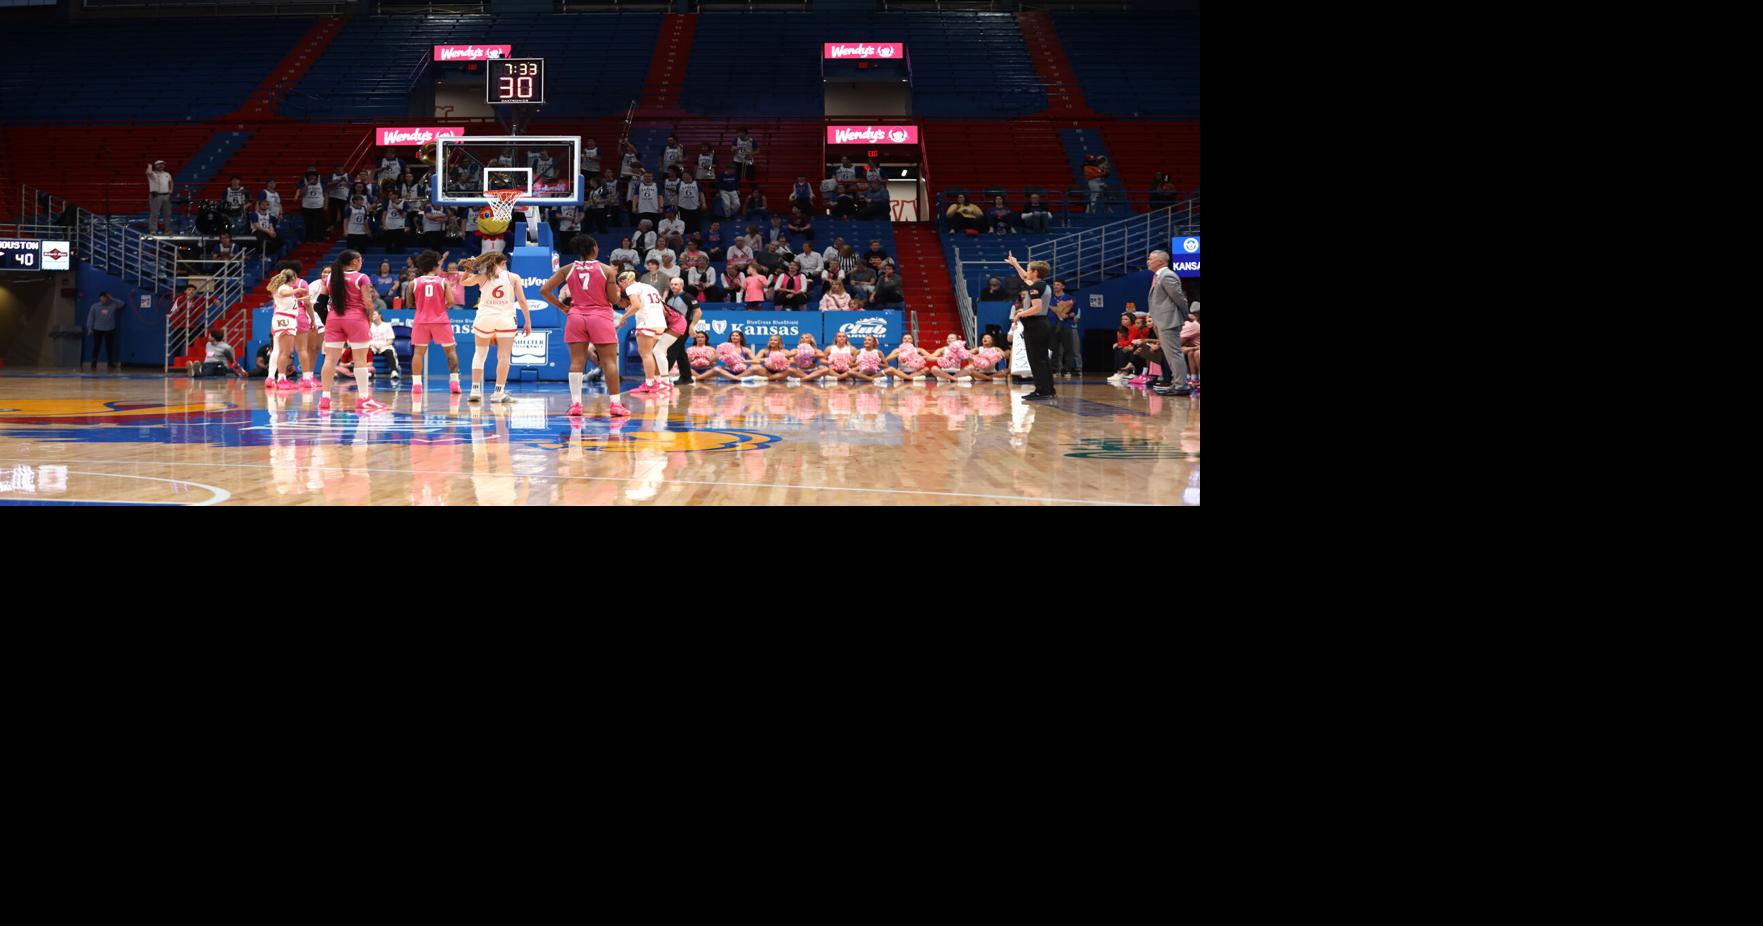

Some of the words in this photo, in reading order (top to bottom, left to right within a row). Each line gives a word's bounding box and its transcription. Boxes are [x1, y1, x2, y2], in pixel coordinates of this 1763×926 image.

[441, 46, 483, 60] Wendy's
[831, 43, 875, 58] Wendy's
[505, 63, 538, 75] 7:33
[499, 77, 532, 98] 30
[384, 128, 433, 145] Wendy's
[835, 126, 885, 144] Wendy's
[15, 253, 33, 266] 40
[579, 273, 590, 290] 7
[425, 284, 434, 297] 0
[492, 285, 504, 299] 6
[647, 293, 660, 304] 13
[277, 319, 290, 327] KU
[731, 323, 799, 336] Kansas
[839, 323, 887, 335] Club
